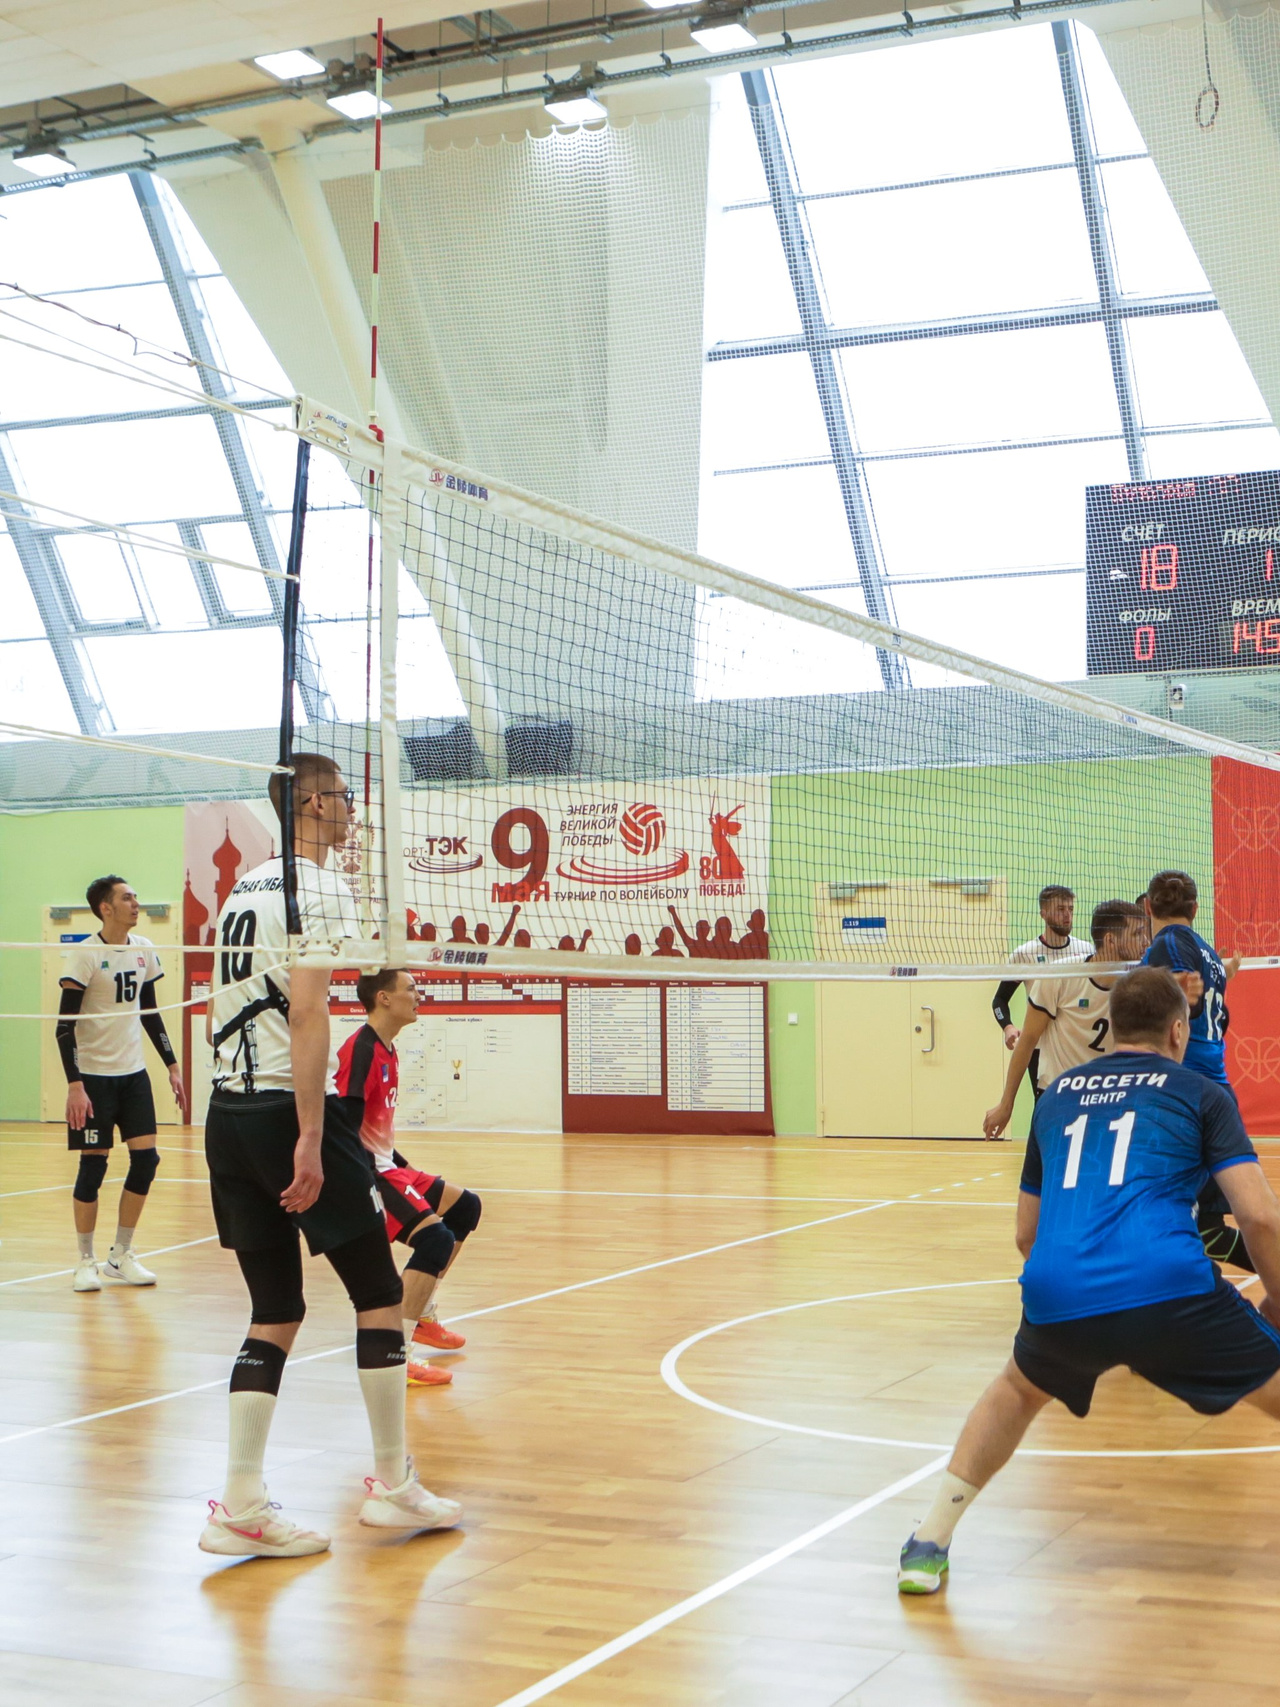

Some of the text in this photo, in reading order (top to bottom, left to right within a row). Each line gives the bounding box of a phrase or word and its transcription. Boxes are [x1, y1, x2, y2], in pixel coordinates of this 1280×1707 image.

[1121, 522, 1166, 541] СЧЁТ
[1141, 544, 1178, 590] 18
[1266, 549, 1273, 581] 1
[1118, 608, 1172, 623] ФОЛЫ
[1134, 627, 1155, 661] 0
[567, 803, 618, 816] ЭНЕРГИЯ
[560, 816, 616, 831] ВЕЛИКОЙ
[491, 807, 550, 890] 9
[562, 834, 613, 847] ПОБЕДЫ
[699, 856, 722, 880] 80
[554, 885, 690, 901] ТУРНИР ПО ВОЛЕЙБОЛУ
[699, 884, 746, 897] ПОБЕДА!
[222, 909, 257, 986] 10
[114, 971, 137, 1003] 15
[1088, 1018, 1110, 1052] 2
[1057, 1072, 1169, 1094] РОССЕТИ
[1080, 1091, 1126, 1106] ЦЕНТР
[84, 1129, 99, 1144] 15
[1062, 1111, 1136, 1190] 11
